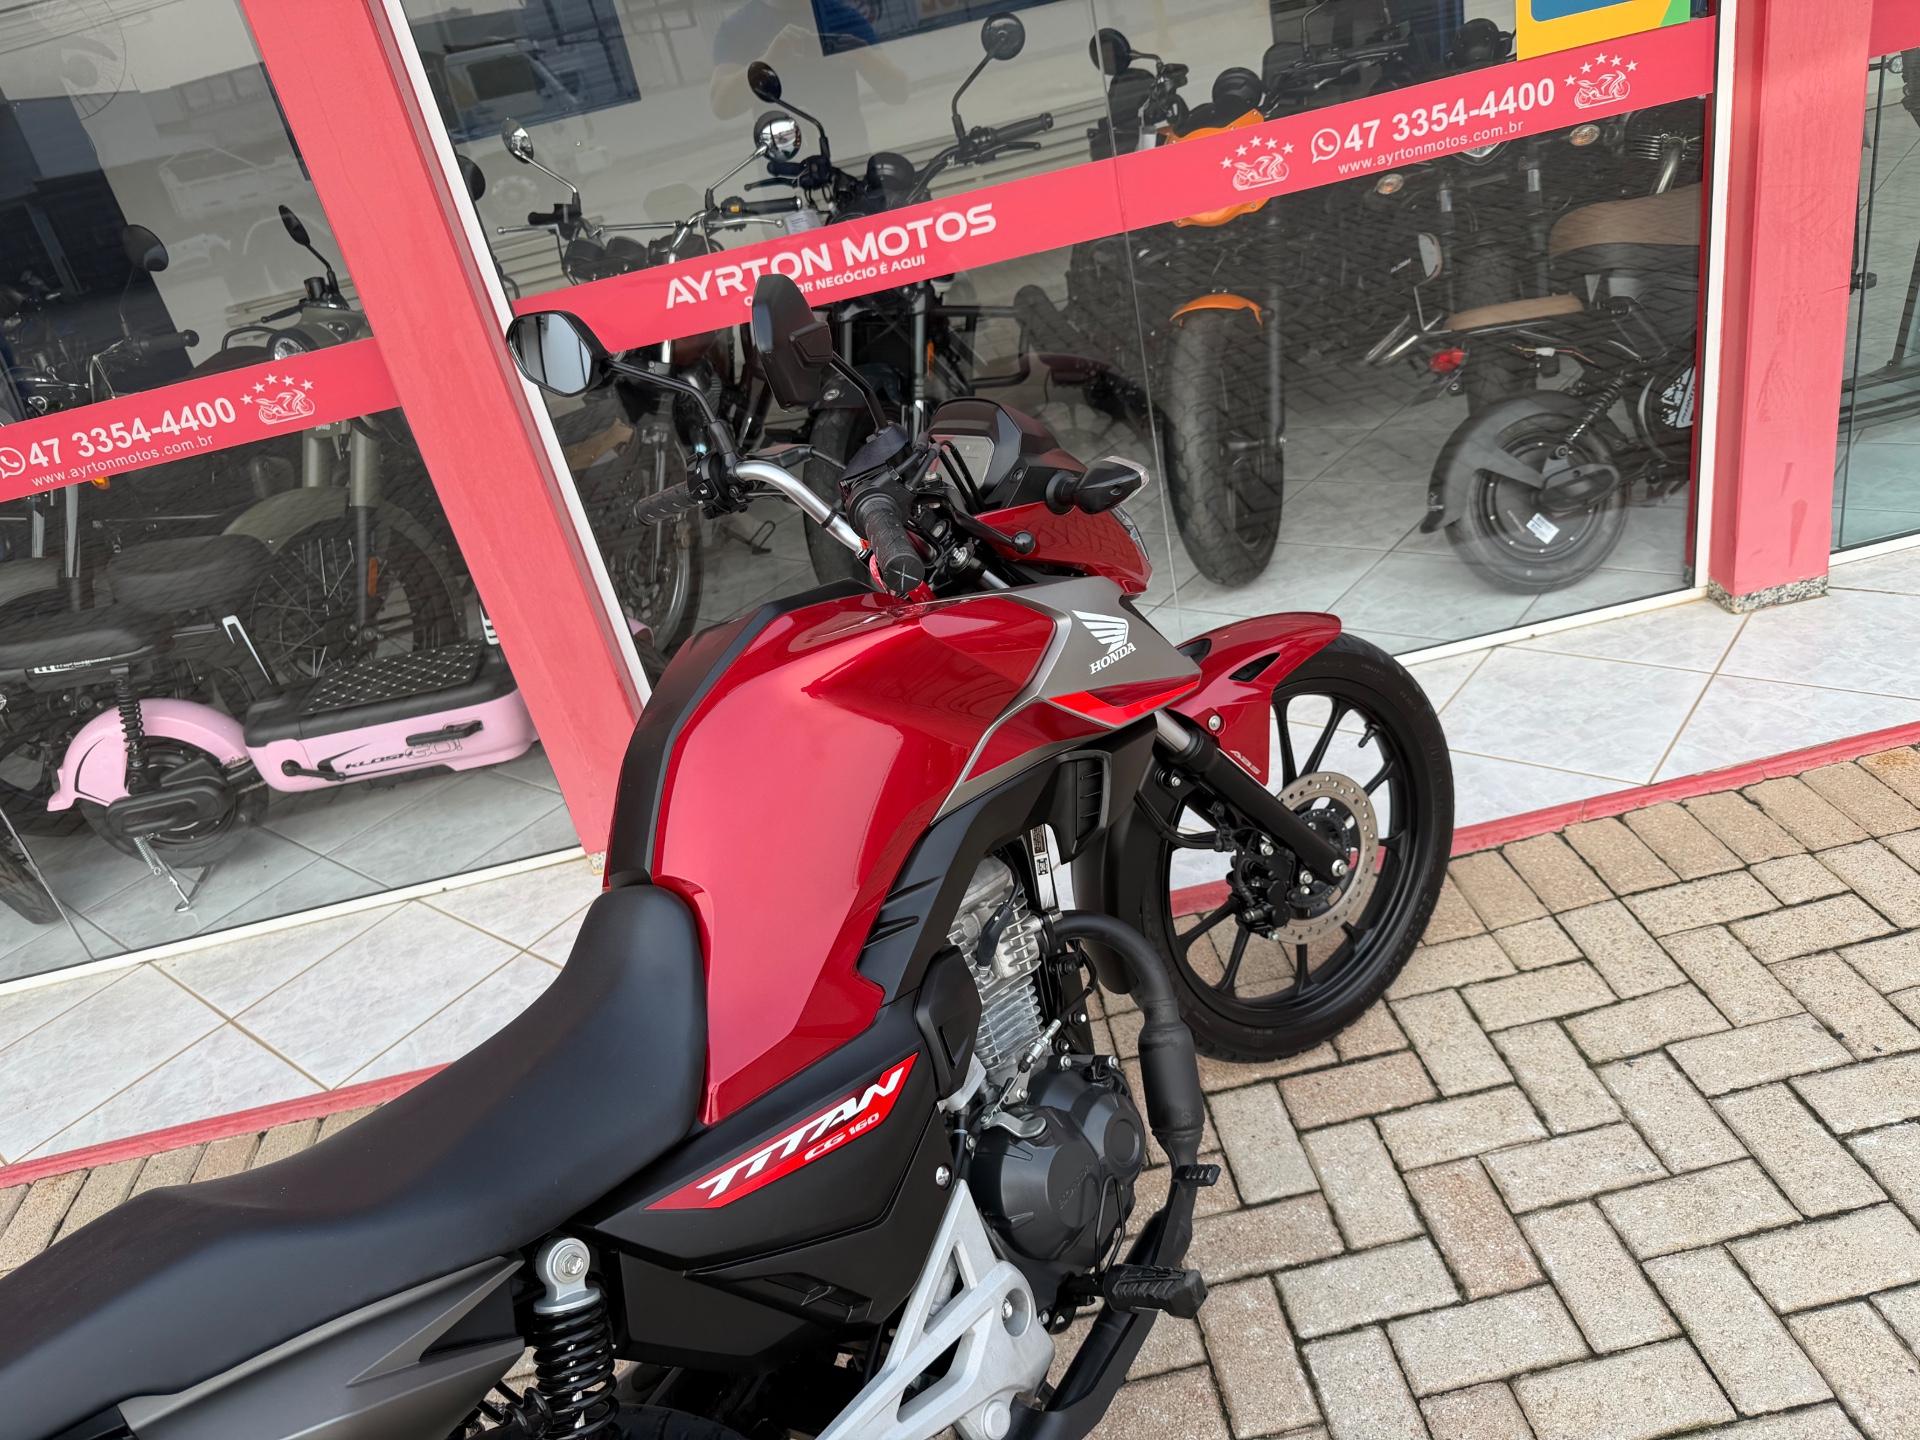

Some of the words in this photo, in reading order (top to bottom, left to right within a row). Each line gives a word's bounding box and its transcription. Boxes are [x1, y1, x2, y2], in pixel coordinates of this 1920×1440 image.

[1343, 119, 1381, 152] 47
[1391, 78, 1555, 142] 3354-4400
[1338, 119, 1524, 175] www.ayrtonmotos.com.br
[665, 243, 833, 309] AYRTON
[841, 203, 997, 267] MOTOS
[816, 266, 877, 290] NEGÓCIO
[880, 261, 889, 275] É
[891, 254, 926, 273] AQUI
[28, 437, 63, 467] 47
[71, 397, 237, 458] 3354-4400
[31, 434, 213, 487] www.ayrtonmotos.com.br
[1090, 642, 1136, 675] HONDA
[696, 1066, 904, 1199] TITAN
[804, 1131, 846, 1161] CG
[848, 1112, 879, 1136] 160
